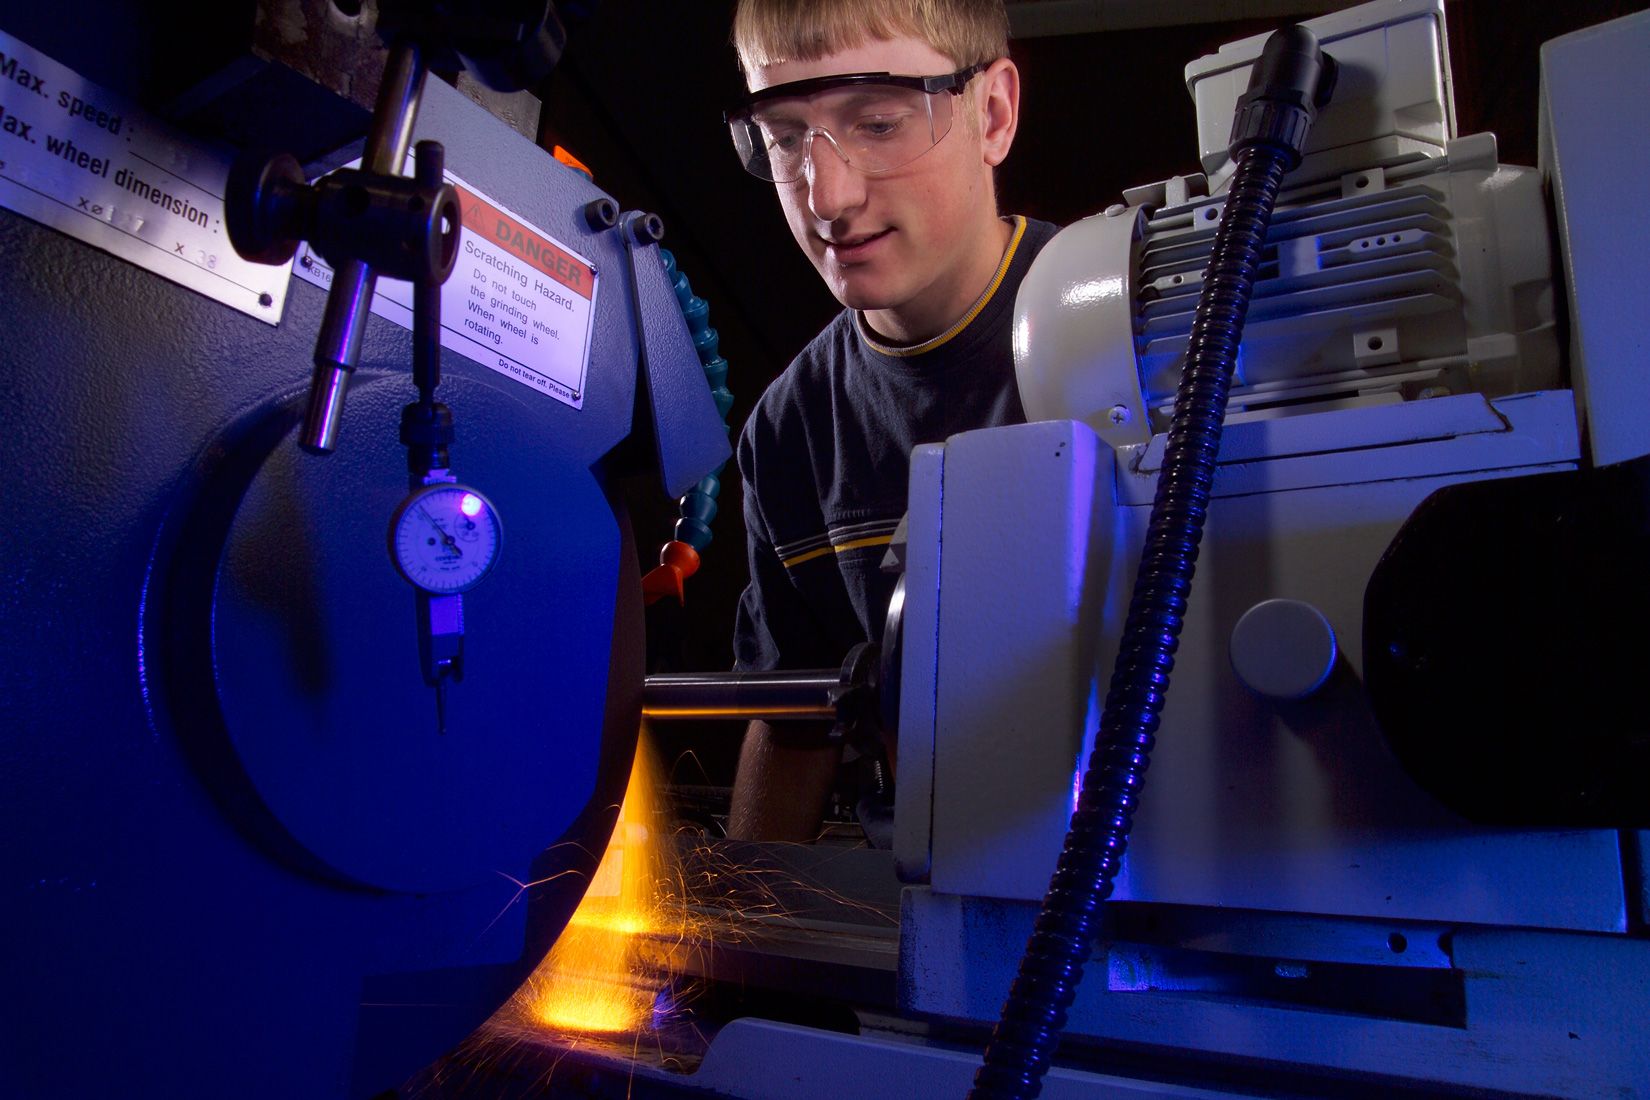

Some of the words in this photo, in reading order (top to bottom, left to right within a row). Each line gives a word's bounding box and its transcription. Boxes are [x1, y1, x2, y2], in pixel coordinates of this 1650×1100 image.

[0, 52, 48, 98] Max.
[58, 91, 122, 135] speed
[0, 105, 36, 144] ax.
[47, 135, 110, 178] wheel
[115, 169, 209, 228] dimension
[465, 240, 528, 288] Scratching
[534, 279, 575, 312] Hazard.
[496, 219, 583, 286] DANGER
[470, 284, 486, 300] the
[490, 297, 528, 325] grinding
[533, 320, 560, 340] wheel.
[473, 268, 487, 283] Do
[491, 279, 508, 295] not
[511, 290, 537, 311] touch
[464, 318, 503, 345] rotating.
[468, 300, 495, 322] When
[500, 319, 527, 339] wheel
[531, 333, 539, 345] is
[498, 358, 509, 369] Do
[510, 365, 522, 375] not
[522, 370, 538, 382] tear
[548, 383, 570, 399] Please
